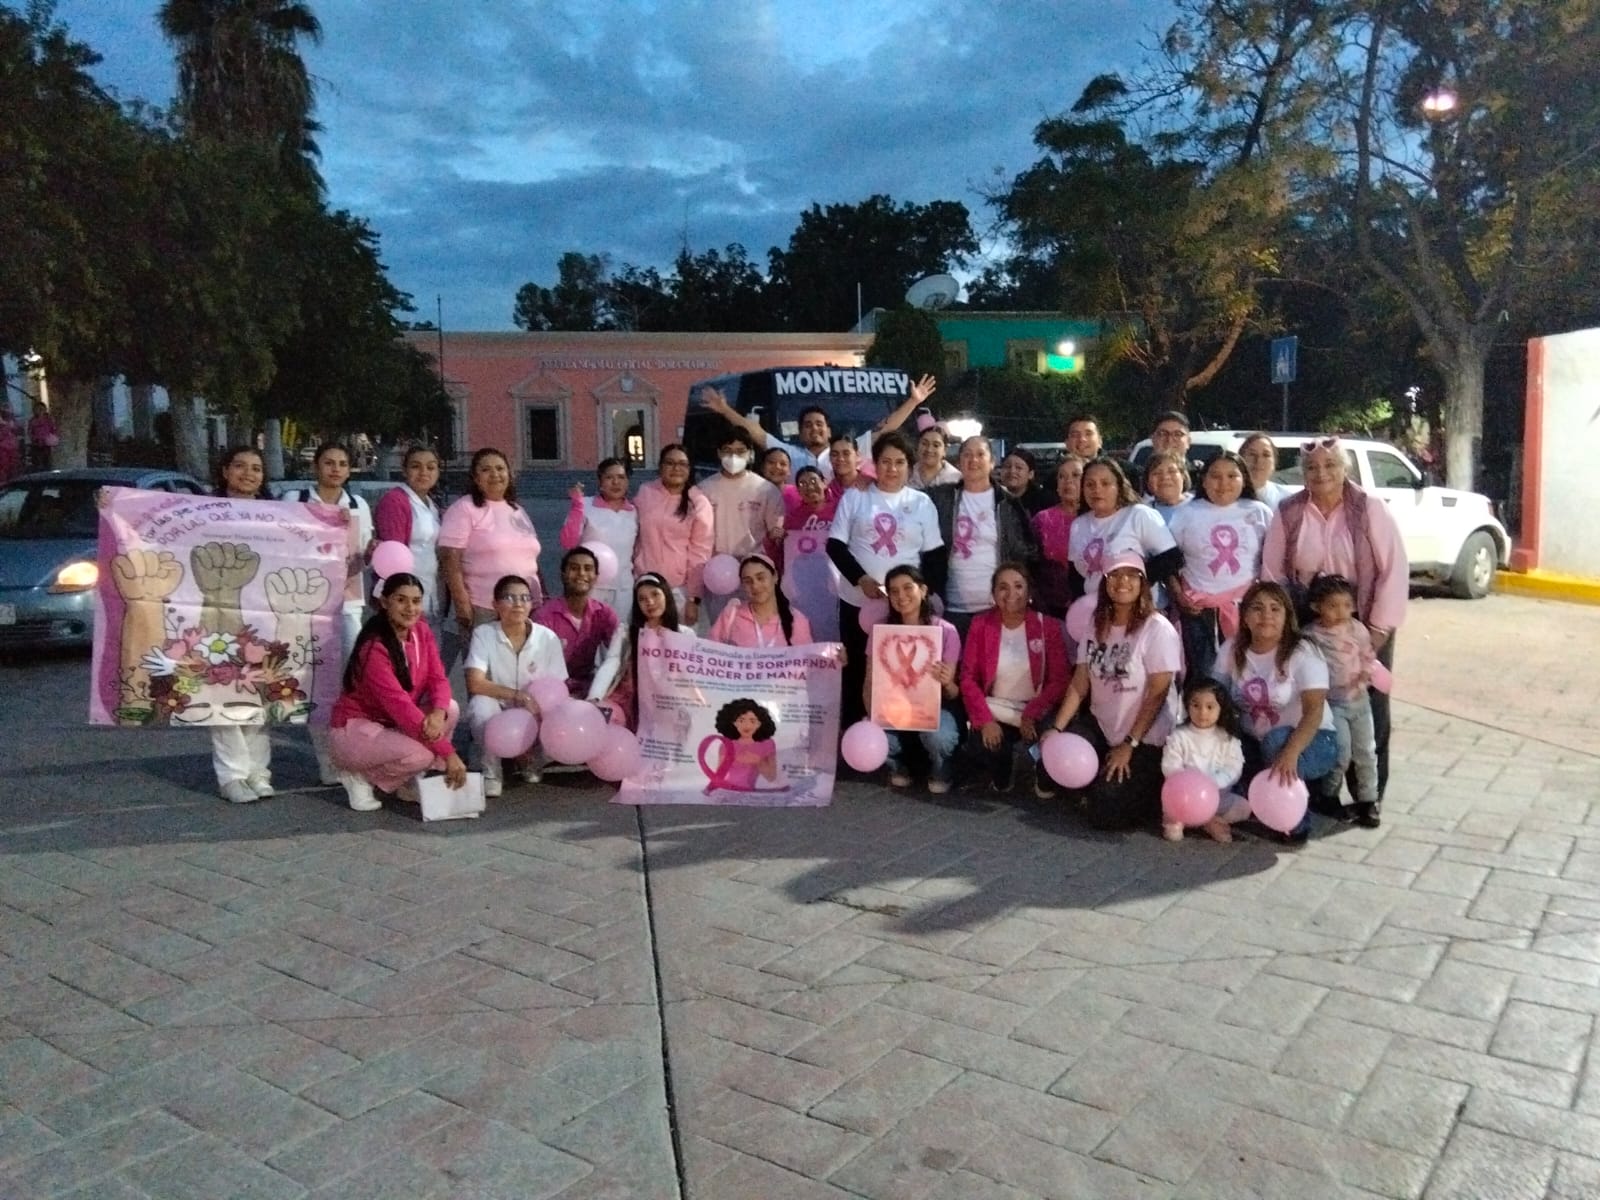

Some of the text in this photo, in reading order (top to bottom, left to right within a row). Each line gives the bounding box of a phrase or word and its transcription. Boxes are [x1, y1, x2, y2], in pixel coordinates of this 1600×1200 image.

[775, 371, 908, 395] MONTERREY
[157, 527, 185, 545] POR
[181, 515, 207, 531] LAS
[208, 511, 235, 522] QUE
[238, 511, 251, 521] YA
[255, 512, 275, 522] NO
[642, 647, 837, 671] NO DEJES QUE TE SORPRENDA
[668, 662, 683, 673] EL
[745, 672, 763, 681] DE
